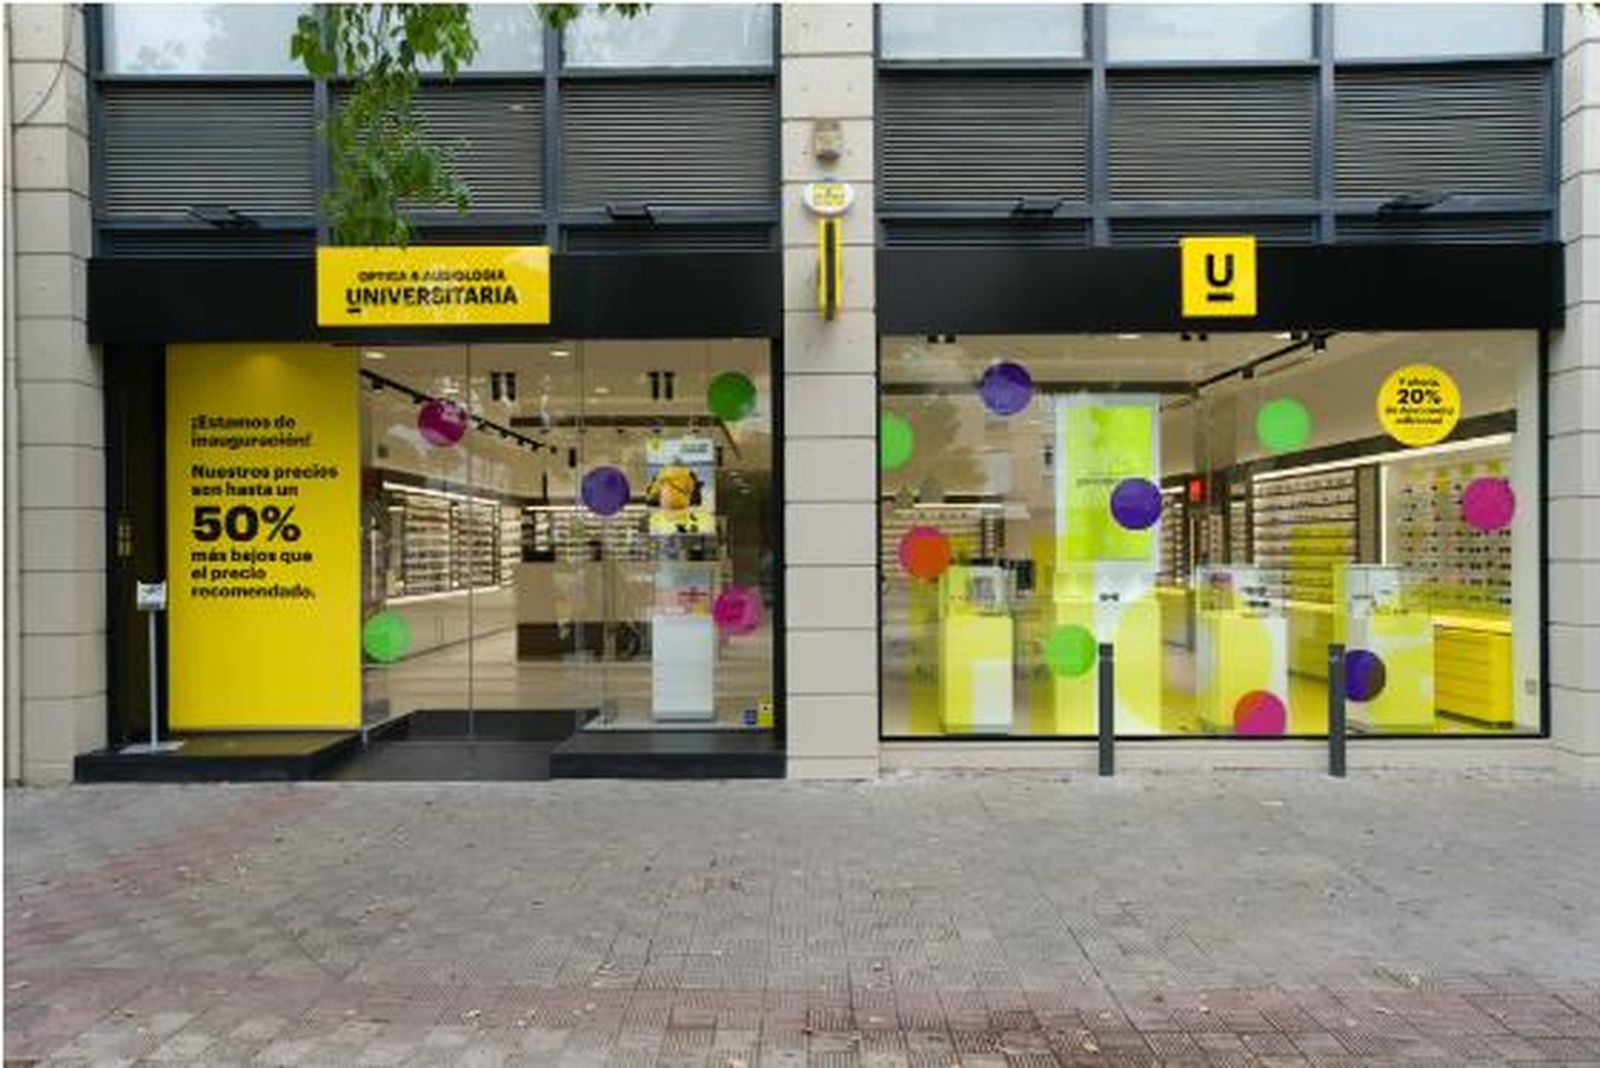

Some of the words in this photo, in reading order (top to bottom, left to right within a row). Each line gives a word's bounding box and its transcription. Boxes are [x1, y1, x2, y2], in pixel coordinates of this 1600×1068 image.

[1206, 253, 1234, 288] U
[345, 286, 518, 307] UNIVERSITARIA
[1397, 389, 1443, 404] 20%
[274, 415, 296, 429] de
[191, 465, 270, 479] Nuestros
[274, 463, 339, 482] precios
[191, 485, 222, 496] son
[225, 482, 272, 496] hasta
[276, 486, 299, 496] un
[192, 505, 301, 542] 50%
[191, 548, 227, 562] más
[230, 548, 276, 564] bajos
[280, 551, 312, 564] que
[191, 567, 207, 579] el
[211, 567, 267, 582] precio
